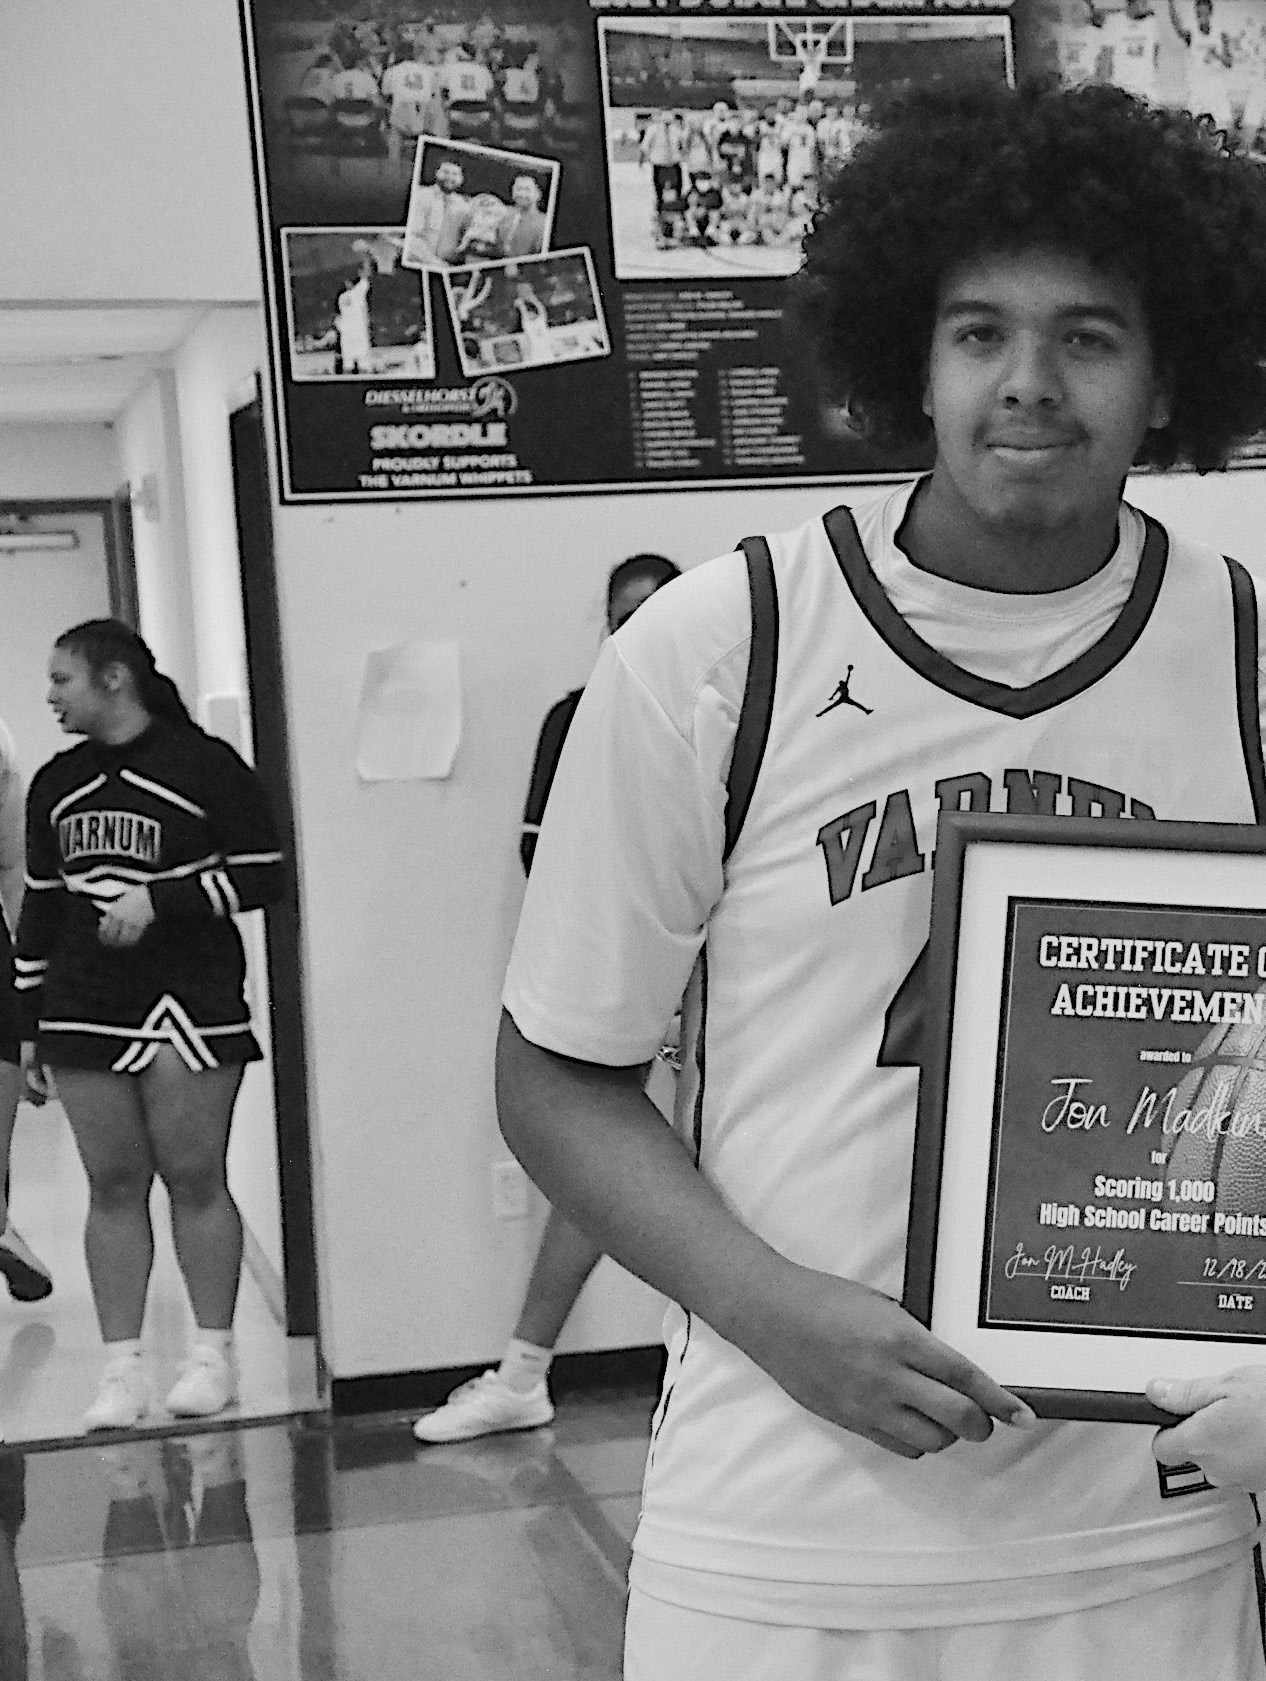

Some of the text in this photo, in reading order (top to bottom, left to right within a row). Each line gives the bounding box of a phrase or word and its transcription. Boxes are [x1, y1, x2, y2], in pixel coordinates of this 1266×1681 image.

[372, 453, 518, 471] PROUDLY SUPPORTS
[358, 468, 533, 488] THE VARNUM WHIPPETS
[59, 809, 161, 863] VARNUM
[815, 769, 1157, 906] VAN
[1039, 935, 1250, 977] CERTIFICATE
[1140, 1050, 1192, 1063] awarded to
[1041, 1077, 1111, 1133] Jon
[1150, 1150, 1168, 1165] for
[1094, 1175, 1216, 1204] Scoring 1,000
[1039, 1202, 1081, 1228] High
[1083, 1205, 1147, 1230] School
[1149, 1208, 1211, 1234] Career
[1050, 1284, 1091, 1301] COACH
[1218, 1293, 1254, 1310] DATE
